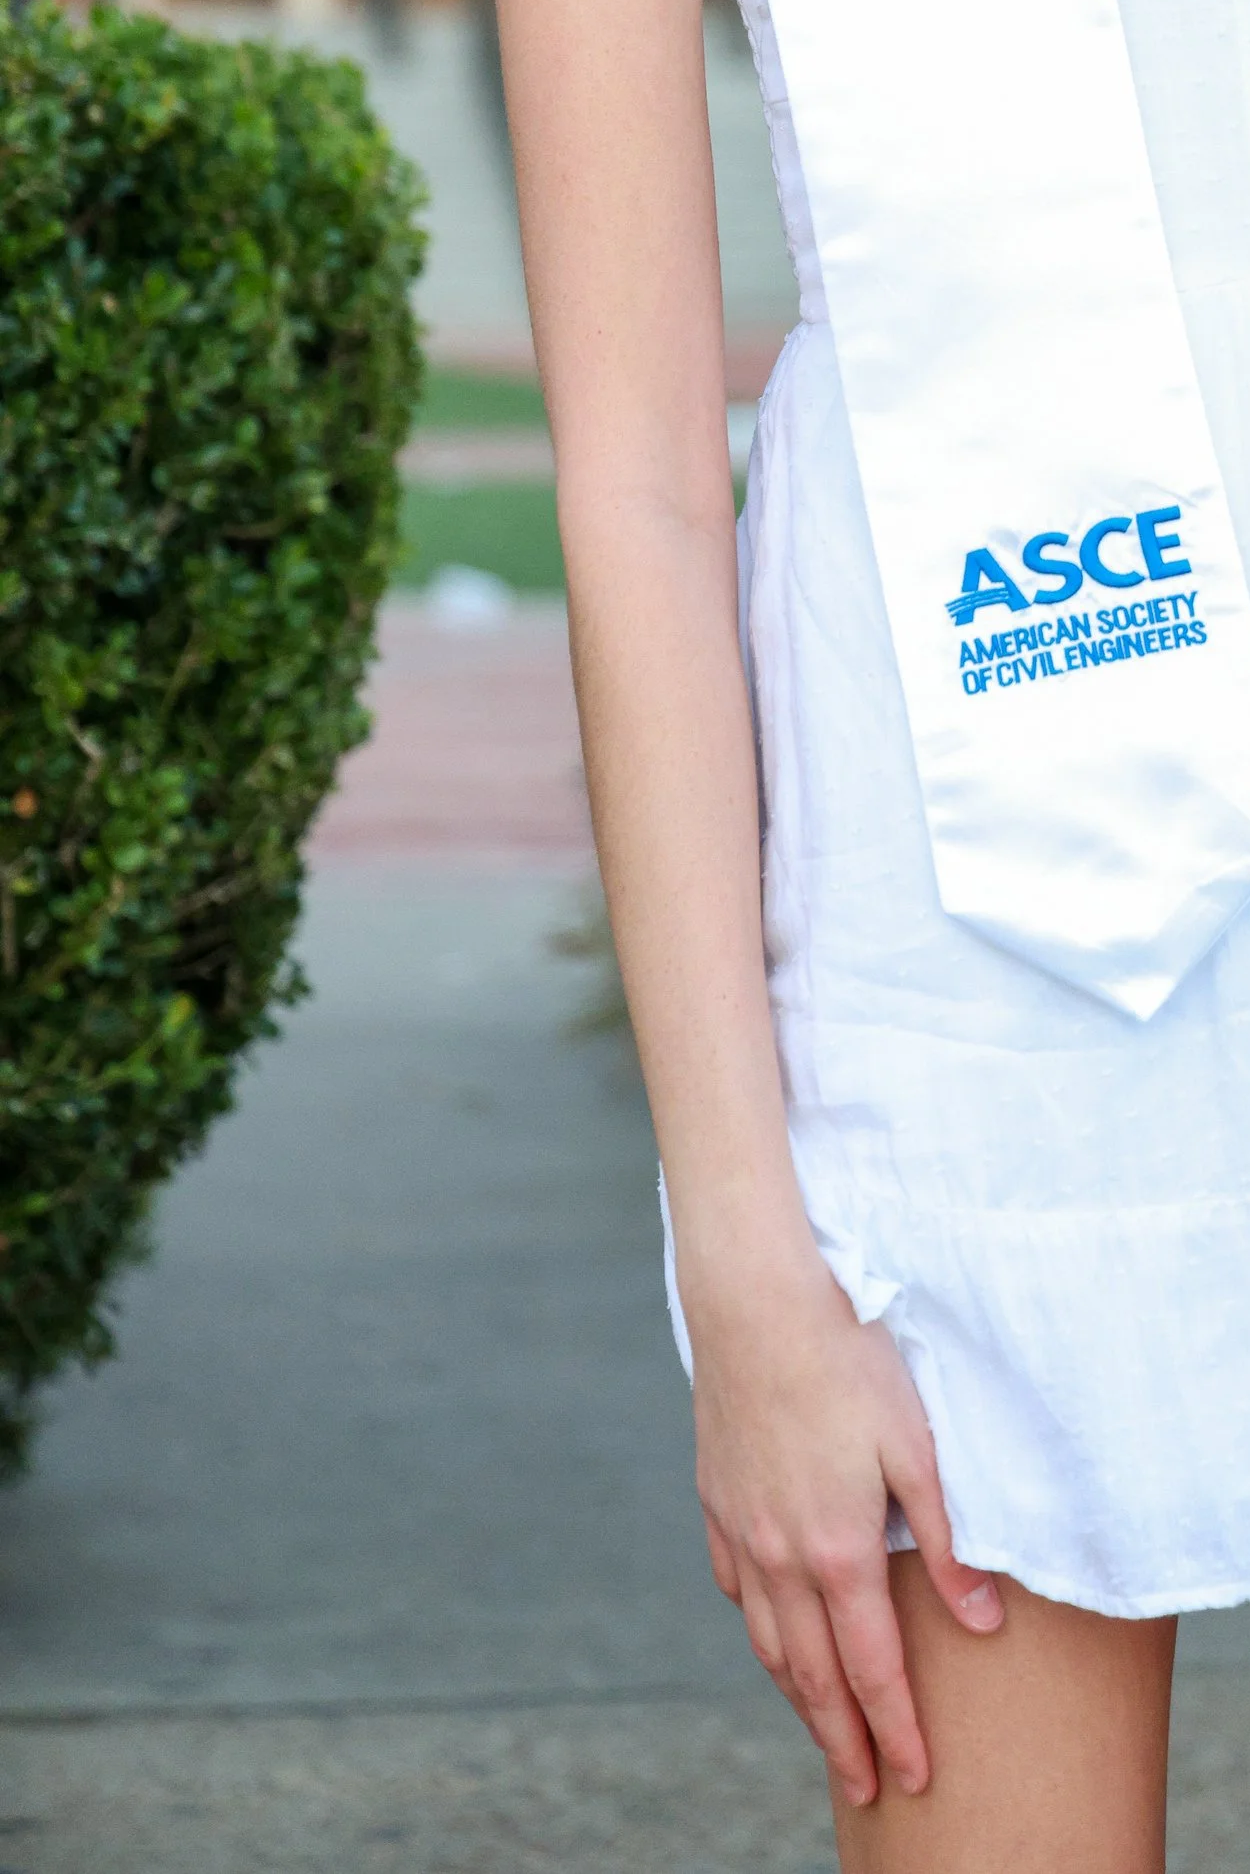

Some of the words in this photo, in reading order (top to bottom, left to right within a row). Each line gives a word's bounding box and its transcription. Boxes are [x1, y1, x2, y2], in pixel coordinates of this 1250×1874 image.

[945, 505, 1192, 627] ASCE
[959, 613, 1092, 668] AMERICAN
[1097, 591, 1198, 634] SOCIETY
[961, 667, 992, 695] OF
[995, 651, 1063, 687] CIVIL
[1064, 621, 1207, 671] ENGINEERS
